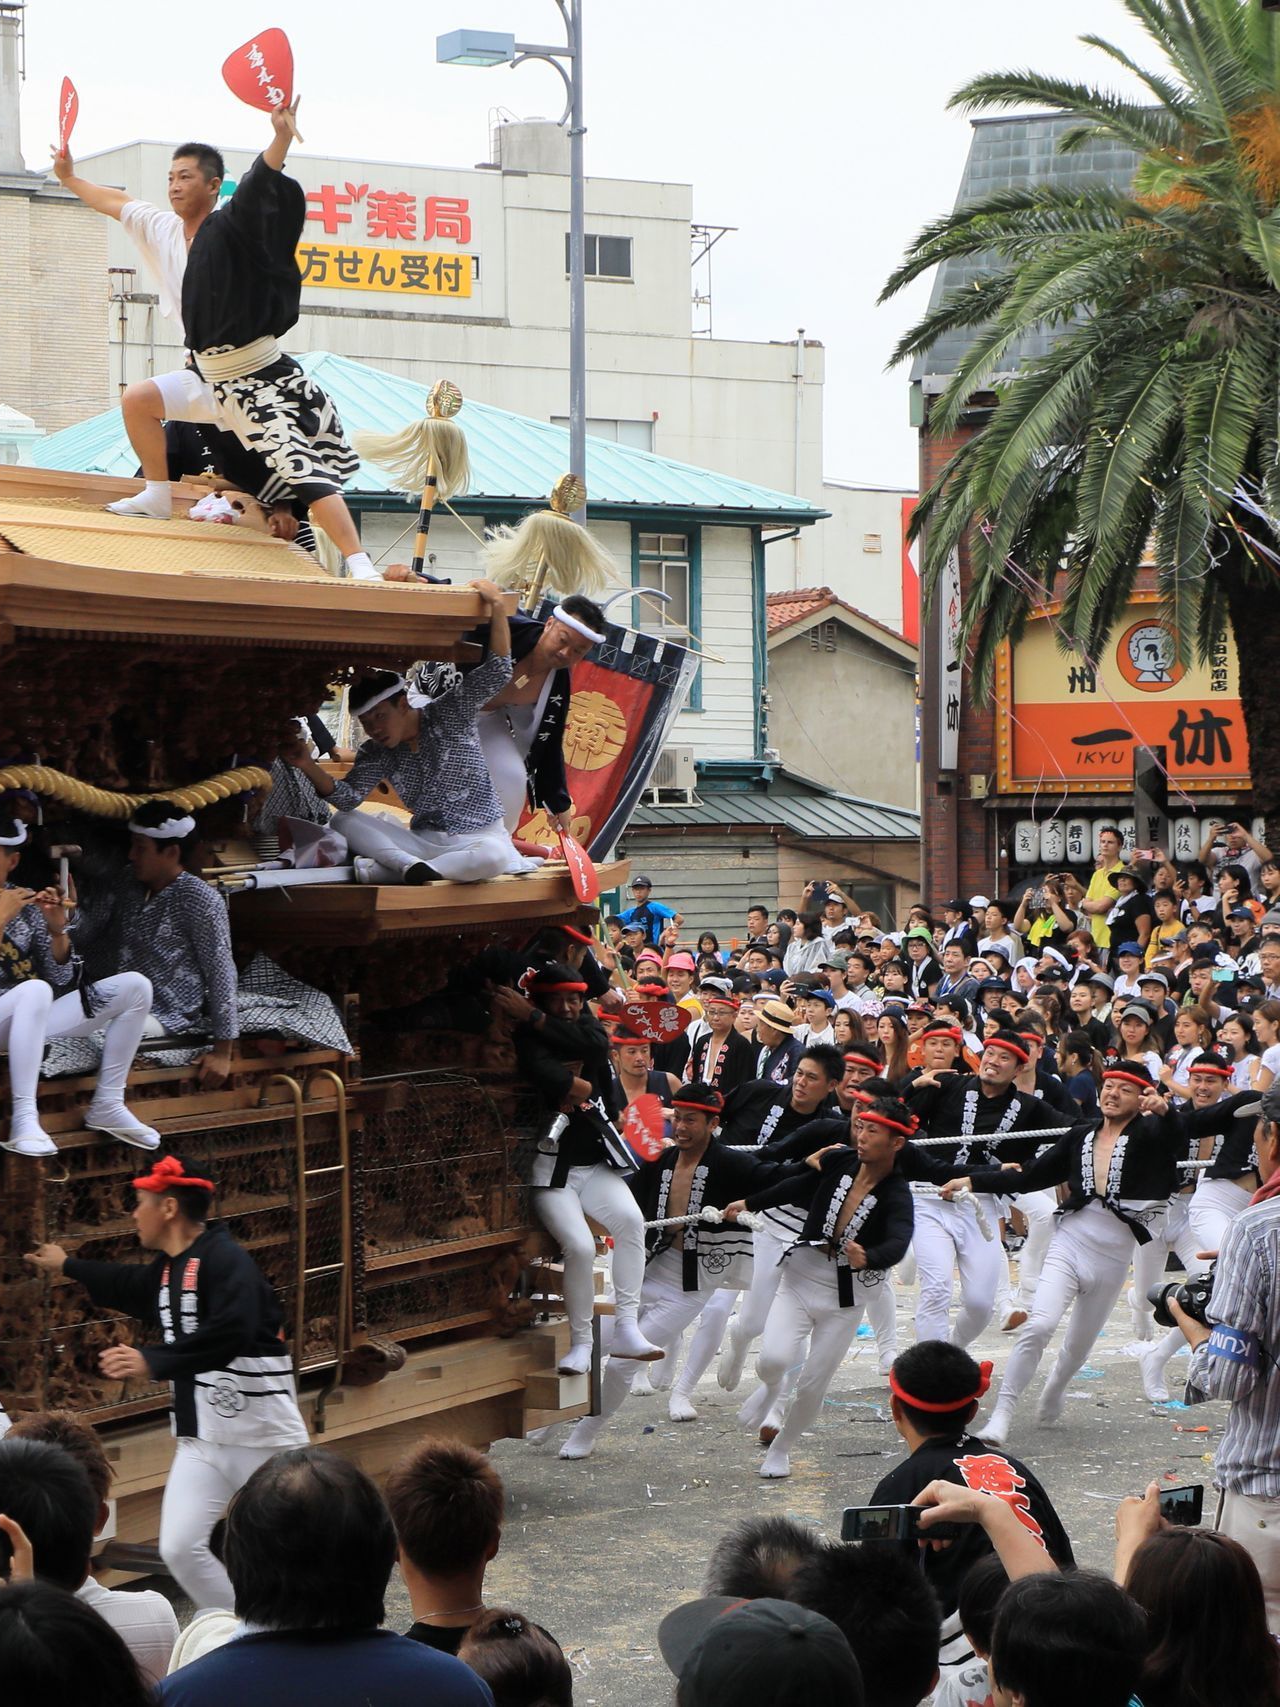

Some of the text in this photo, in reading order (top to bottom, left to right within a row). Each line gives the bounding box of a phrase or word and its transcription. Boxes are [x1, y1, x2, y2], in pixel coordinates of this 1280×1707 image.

[305, 182, 472, 244] ギ薬局
[298, 246, 463, 293] 方せん受付
[1075, 751, 1125, 765] IKYU
